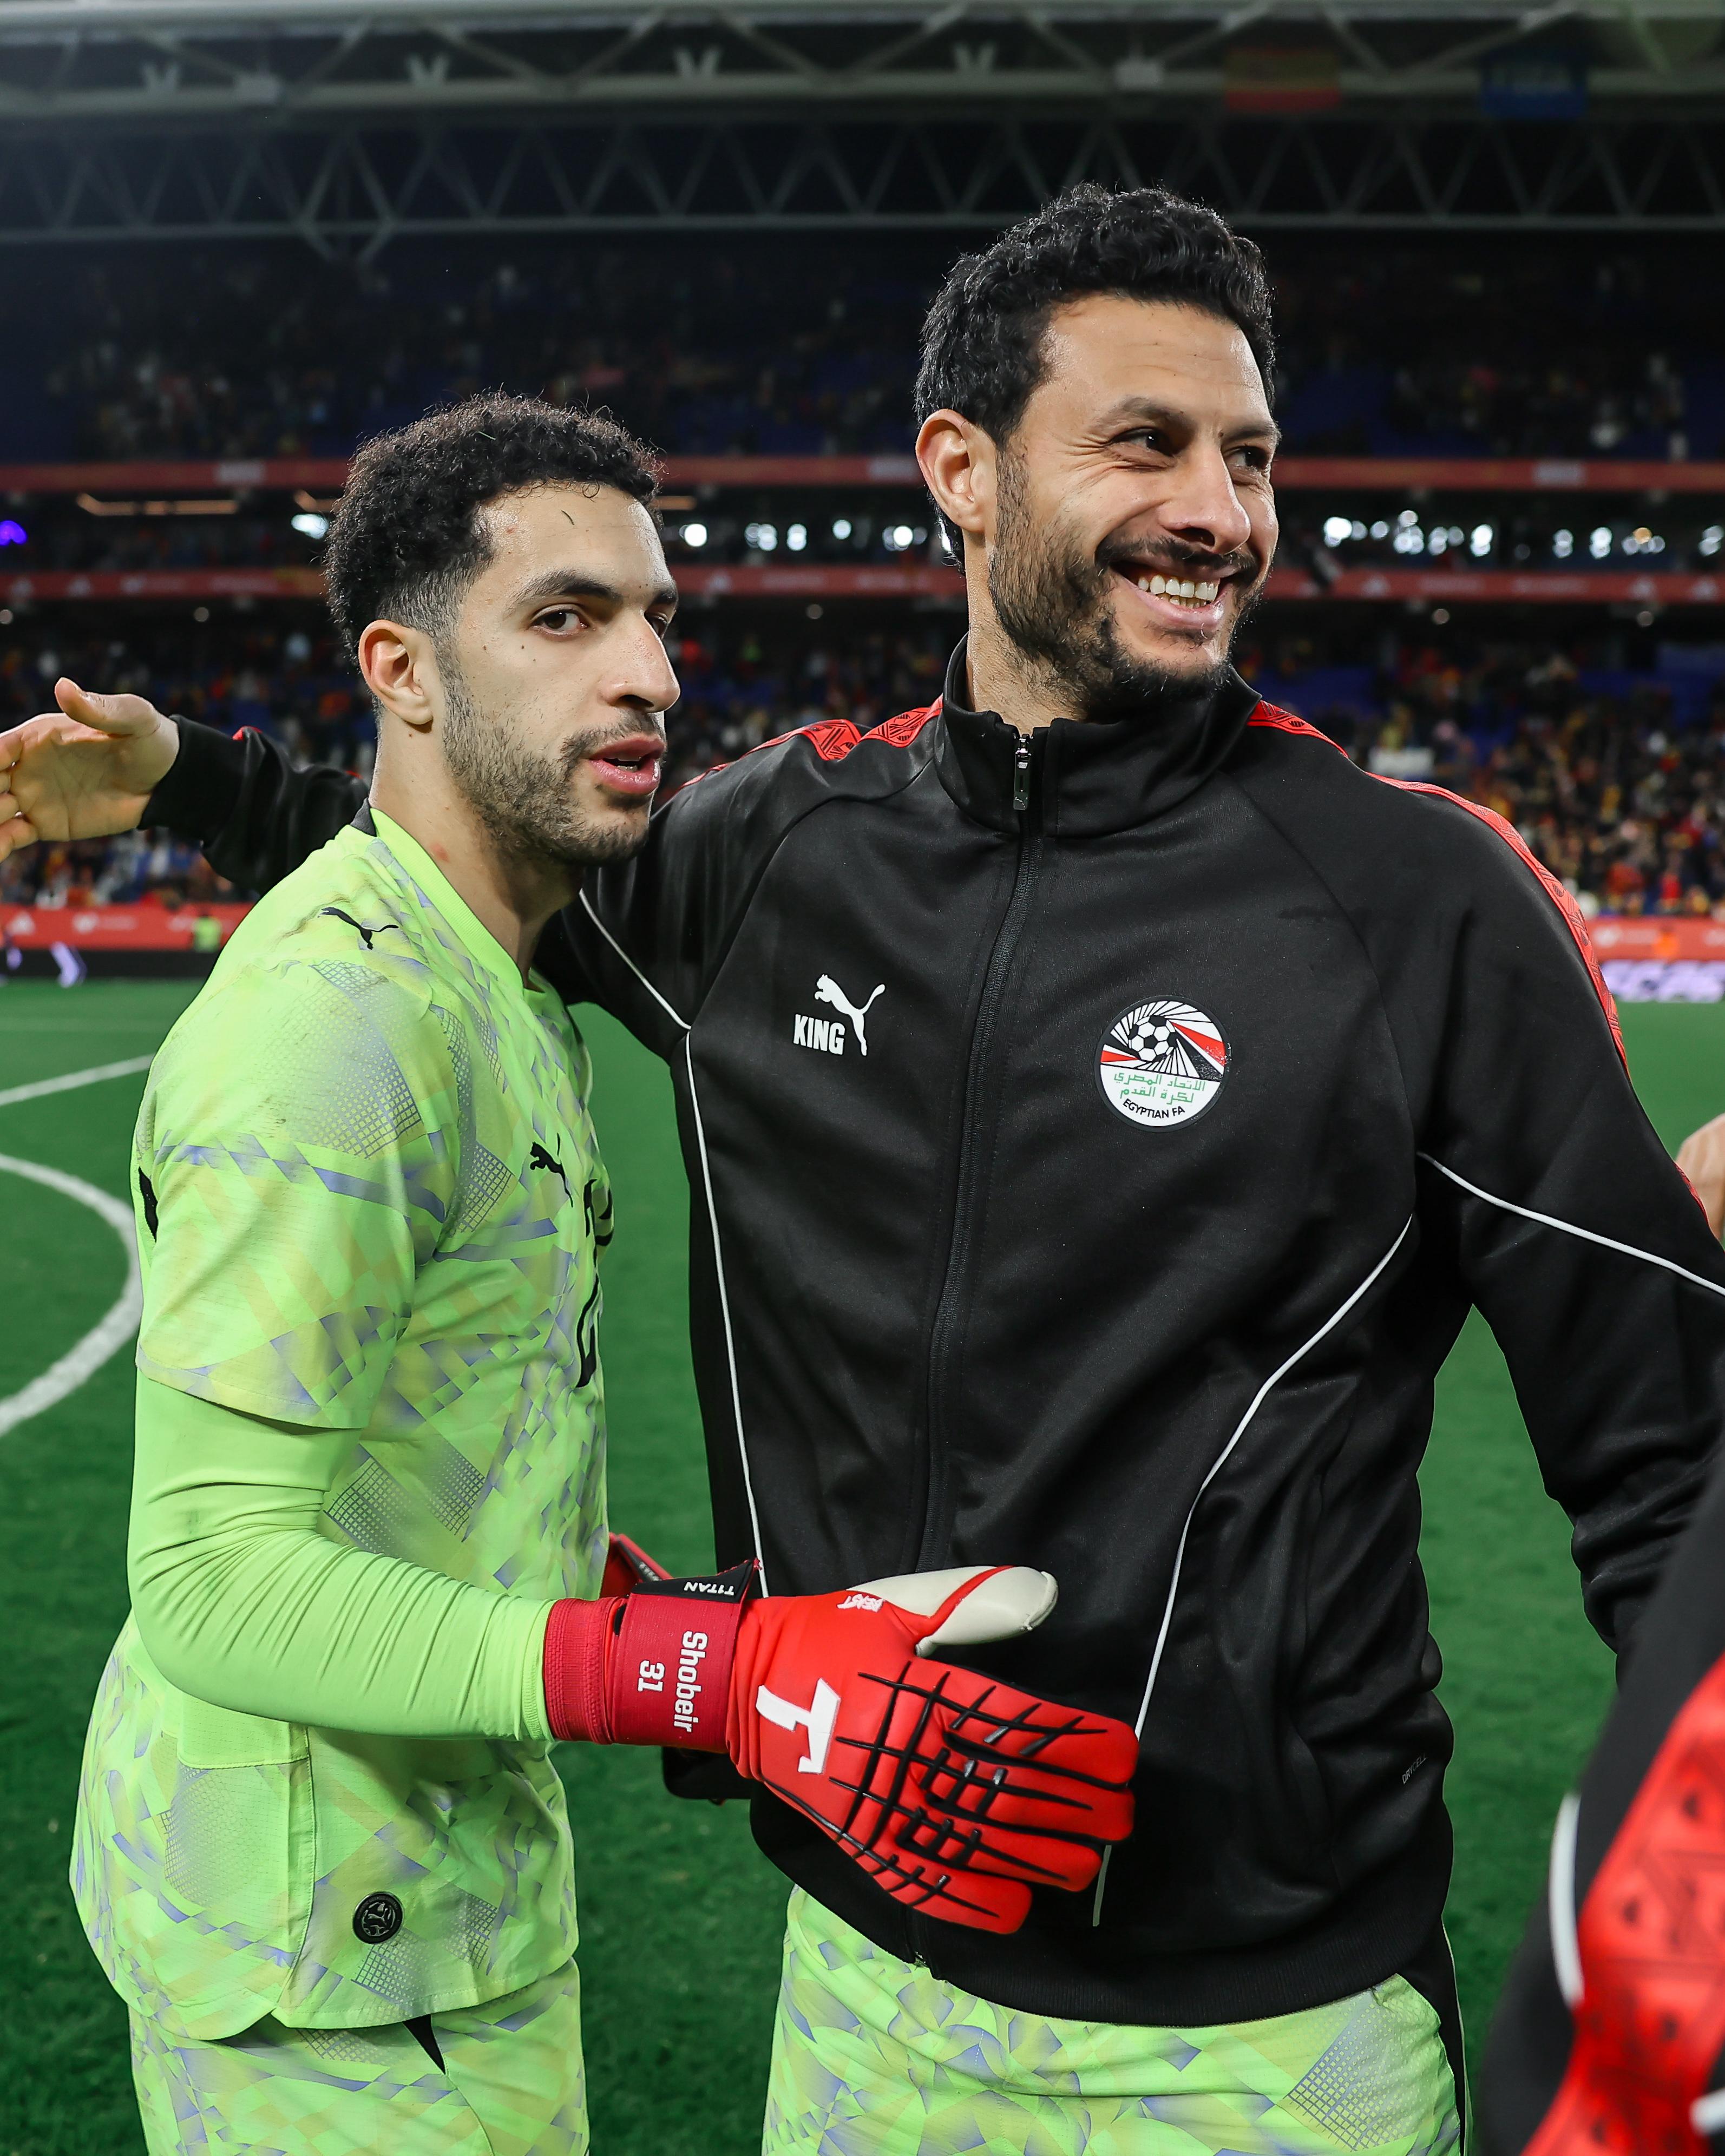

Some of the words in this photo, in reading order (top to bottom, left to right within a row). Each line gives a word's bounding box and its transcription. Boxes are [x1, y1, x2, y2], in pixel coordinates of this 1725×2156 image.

[793, 1014, 845, 1055] KING
[1113, 1072, 1163, 1086] المصري
[1167, 1077, 1206, 1092] الاتحاد
[1120, 1087, 1156, 1099] القدم
[1160, 1089, 1195, 1105] لكرة
[1123, 1098, 1170, 1119] EGYPTIAN
[1172, 1106, 1185, 1117] FA
[684, 1581, 734, 1596] T1TAN
[637, 1660, 666, 1692] 31
[673, 1631, 709, 1732] Shobeir
